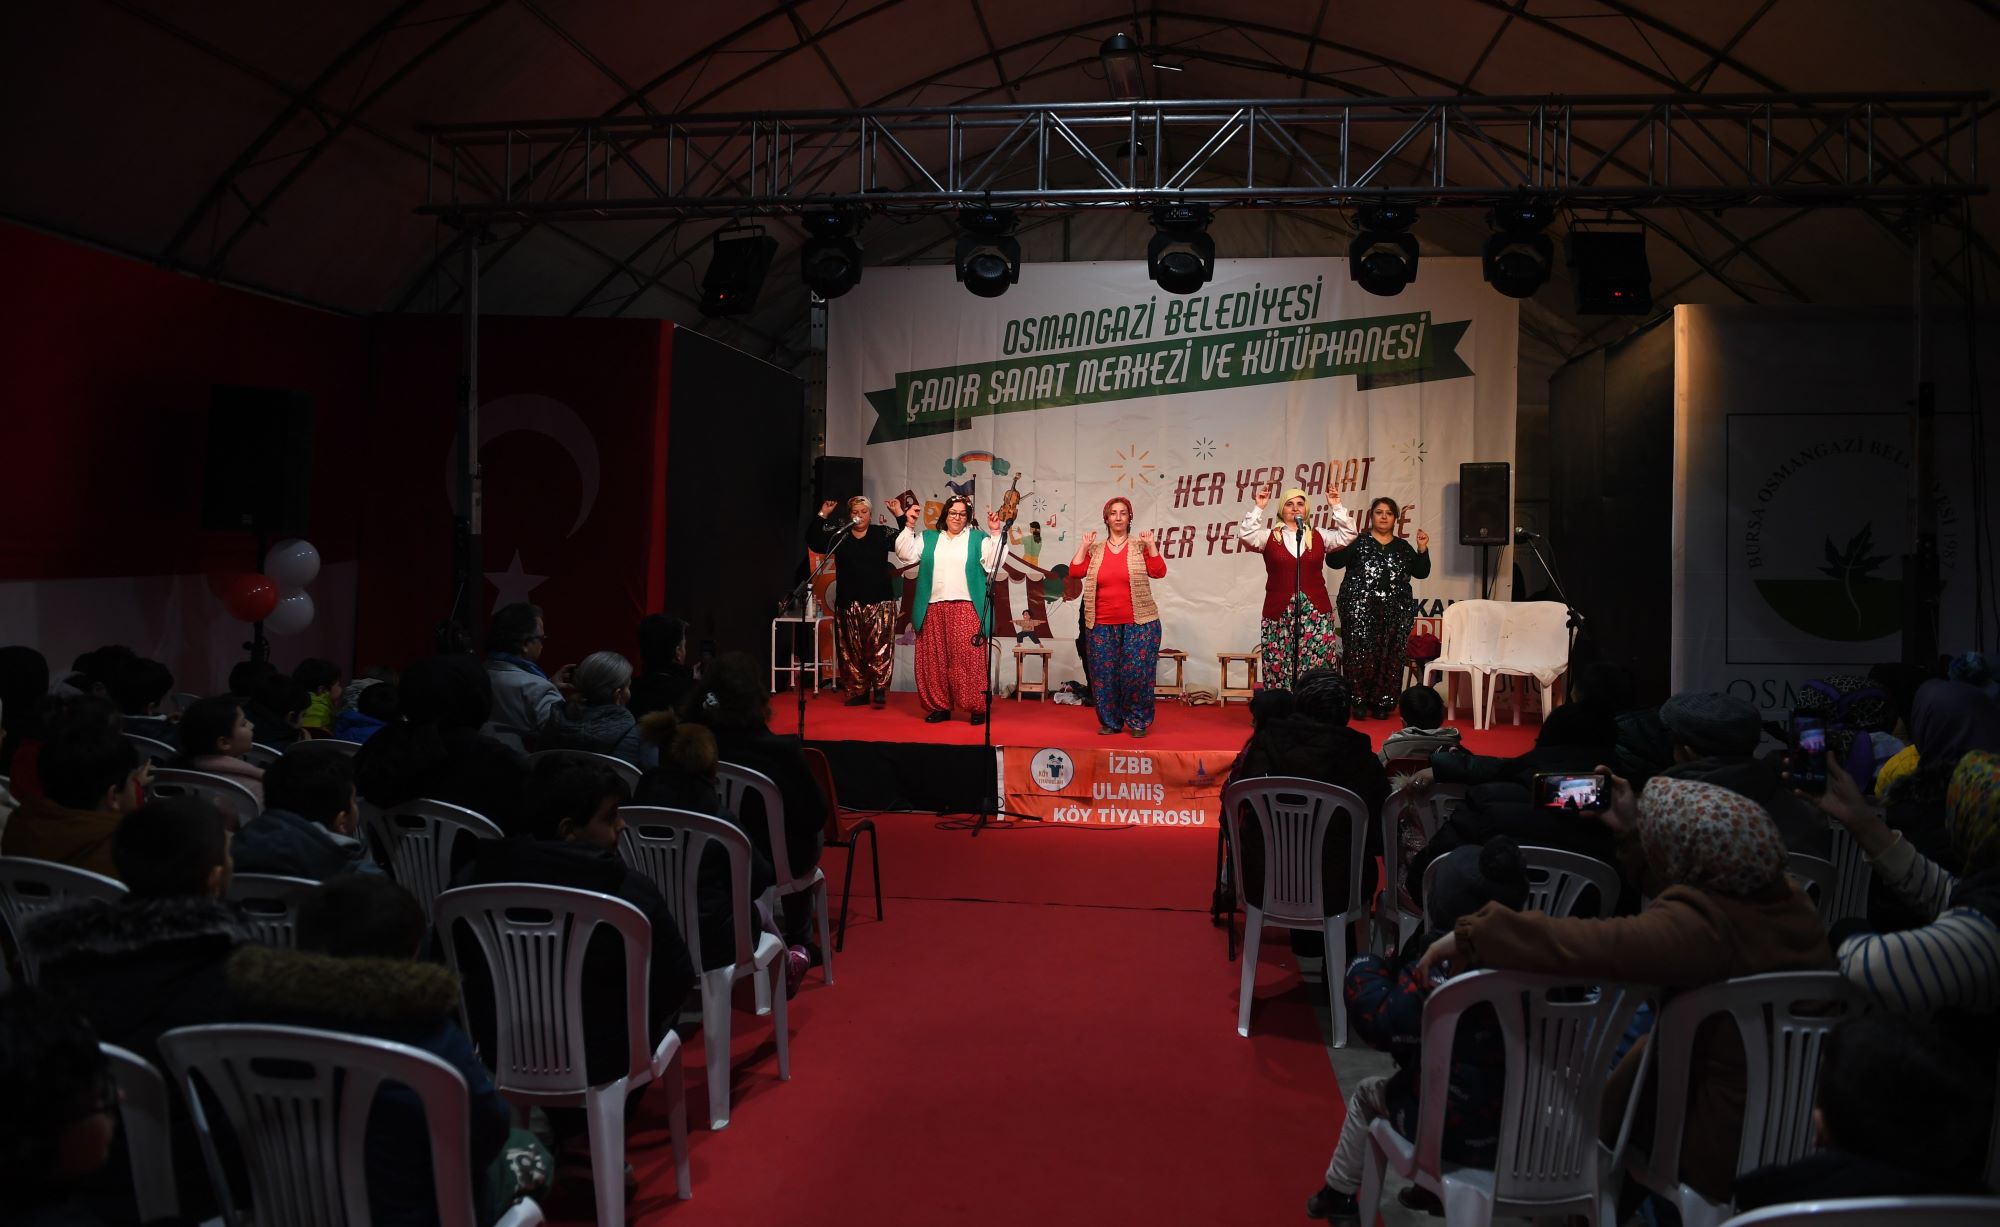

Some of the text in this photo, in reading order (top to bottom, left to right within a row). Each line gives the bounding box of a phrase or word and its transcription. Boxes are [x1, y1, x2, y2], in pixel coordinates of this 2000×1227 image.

[1002, 274, 1323, 356] OSMANGAZİ BELEDİYESİ
[906, 313, 1427, 423] ÇADIR SANAT MERKEZİ VE KÜTÜPHANESİ
[1174, 457, 1376, 509] HER YER SANAT
[1745, 507, 1766, 569] BURSA
[1757, 435, 1864, 503] OSMANGAZİ
[1109, 752, 1153, 774] İZBB
[1053, 804, 1205, 825] KÖY TİYATROSU
[1092, 782, 1165, 806] ULAMIŞ
